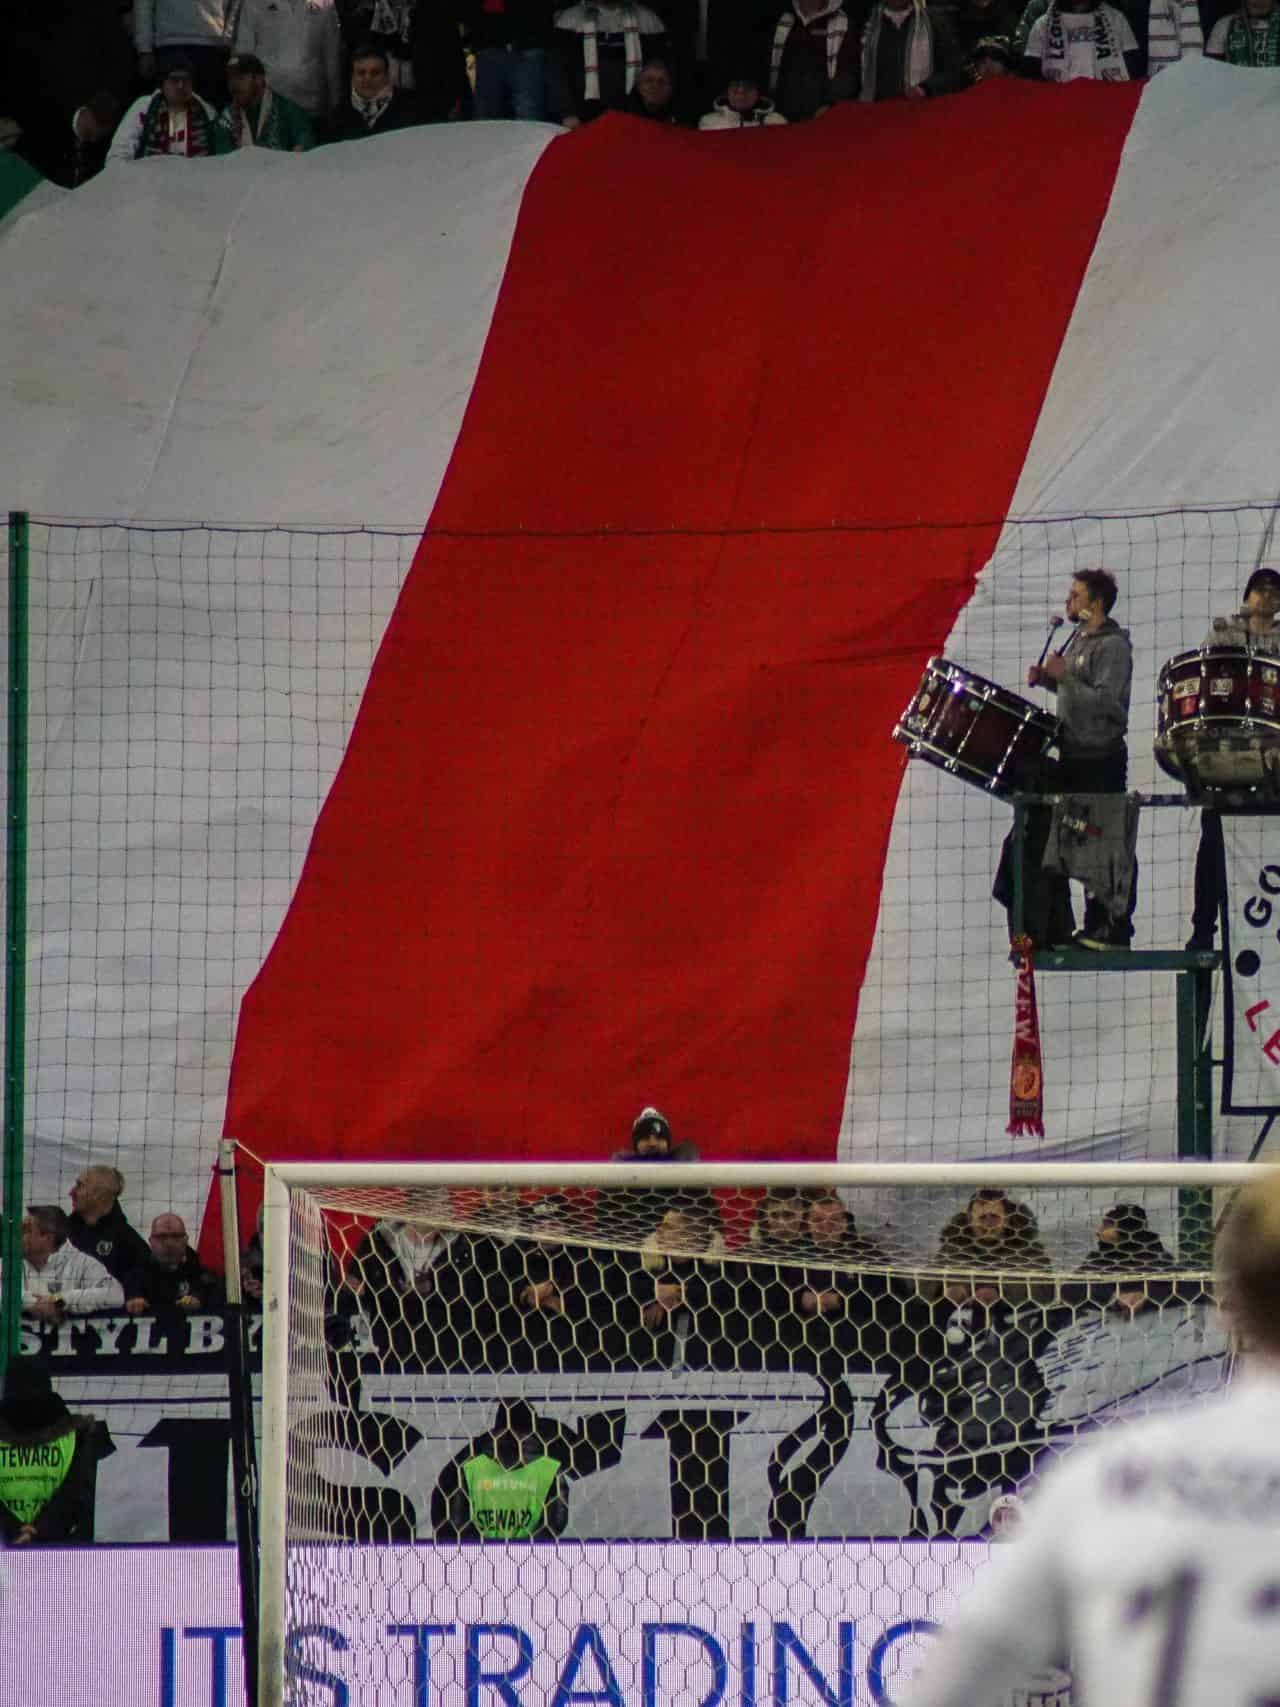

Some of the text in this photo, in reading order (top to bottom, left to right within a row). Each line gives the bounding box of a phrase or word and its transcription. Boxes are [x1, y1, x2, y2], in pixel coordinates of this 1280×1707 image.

[17, 1315, 169, 1357] STYL
[0, 1447, 61, 1468] TEWARD
[476, 1509, 533, 1532] STEWARD
[159, 1622, 350, 1707] ITS
